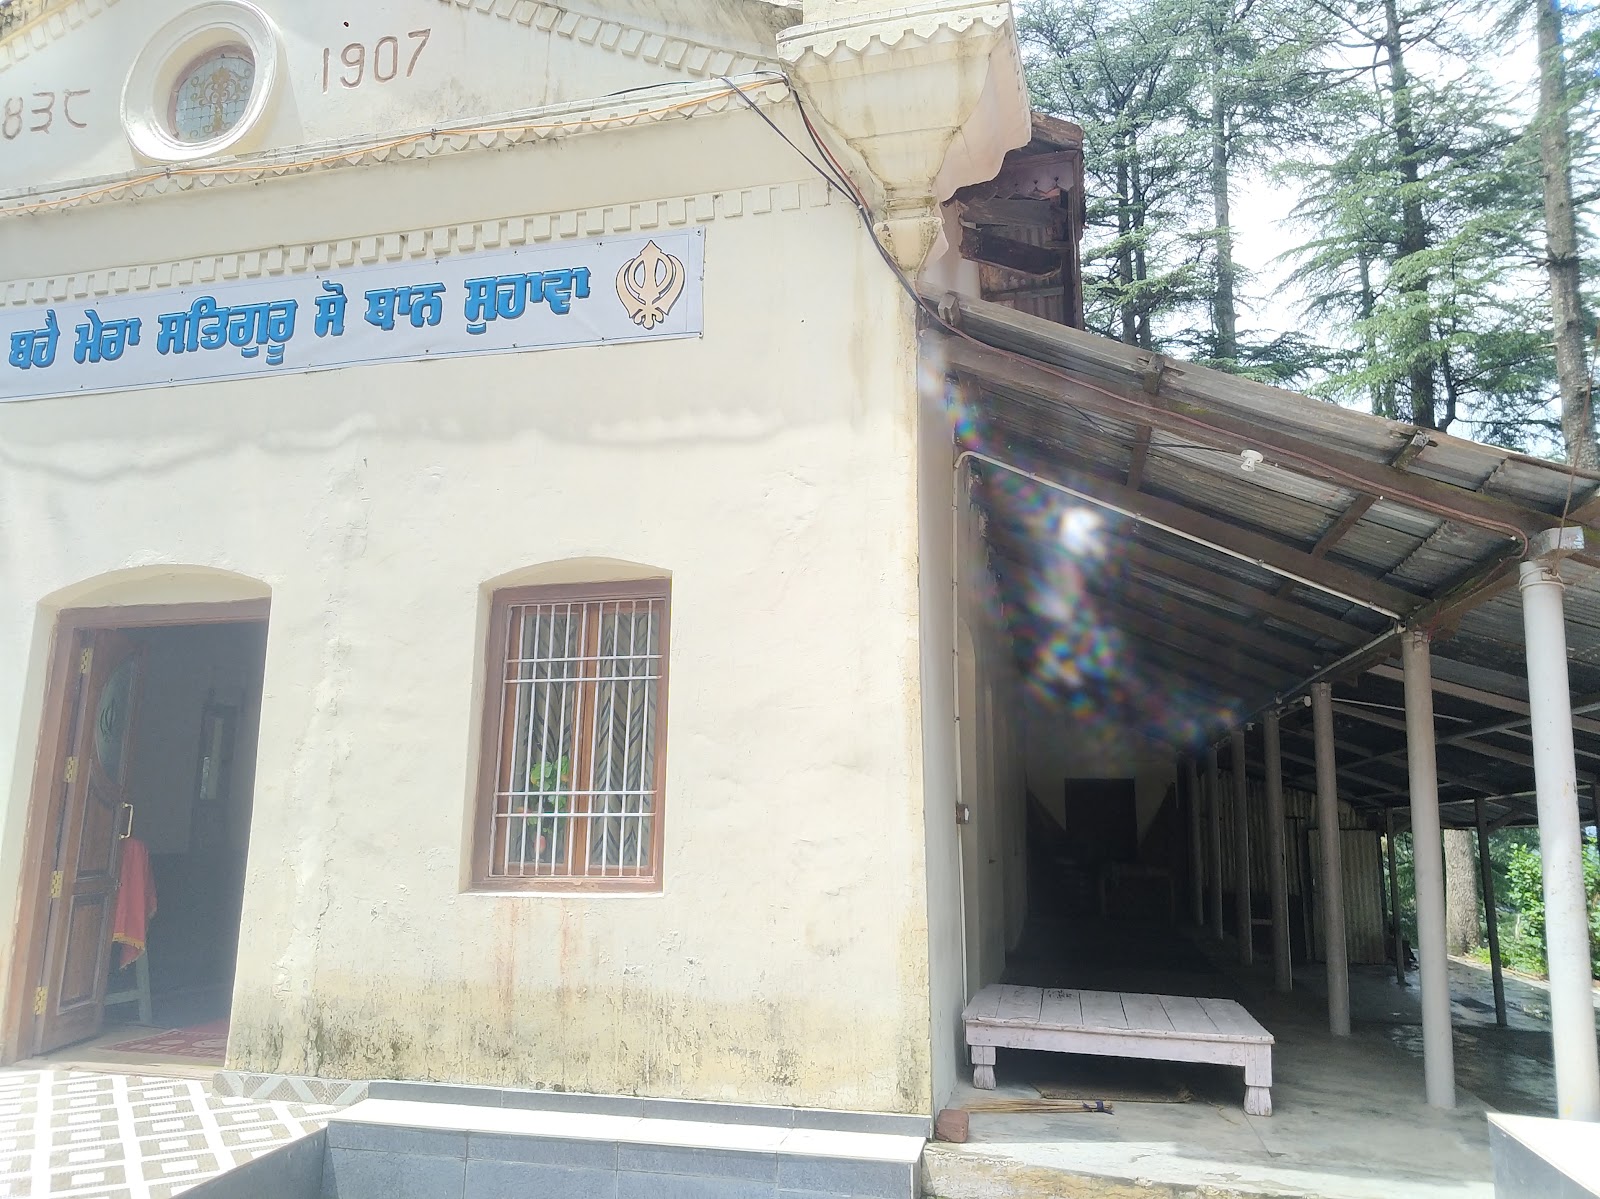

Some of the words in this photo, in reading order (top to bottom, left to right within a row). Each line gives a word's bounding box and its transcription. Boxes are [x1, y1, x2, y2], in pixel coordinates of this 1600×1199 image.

[320, 28, 431, 95] 1907
[9, 309, 61, 370] ਬਹੈ
[74, 309, 142, 364] ਮੇਰਾ
[156, 296, 299, 365] ਸਤਿਗੁਰੂ
[314, 280, 348, 338] ਸੋ
[364, 282, 447, 331] ਥਾਨ
[464, 266, 592, 335] ਸੁਹਾਵਾ
